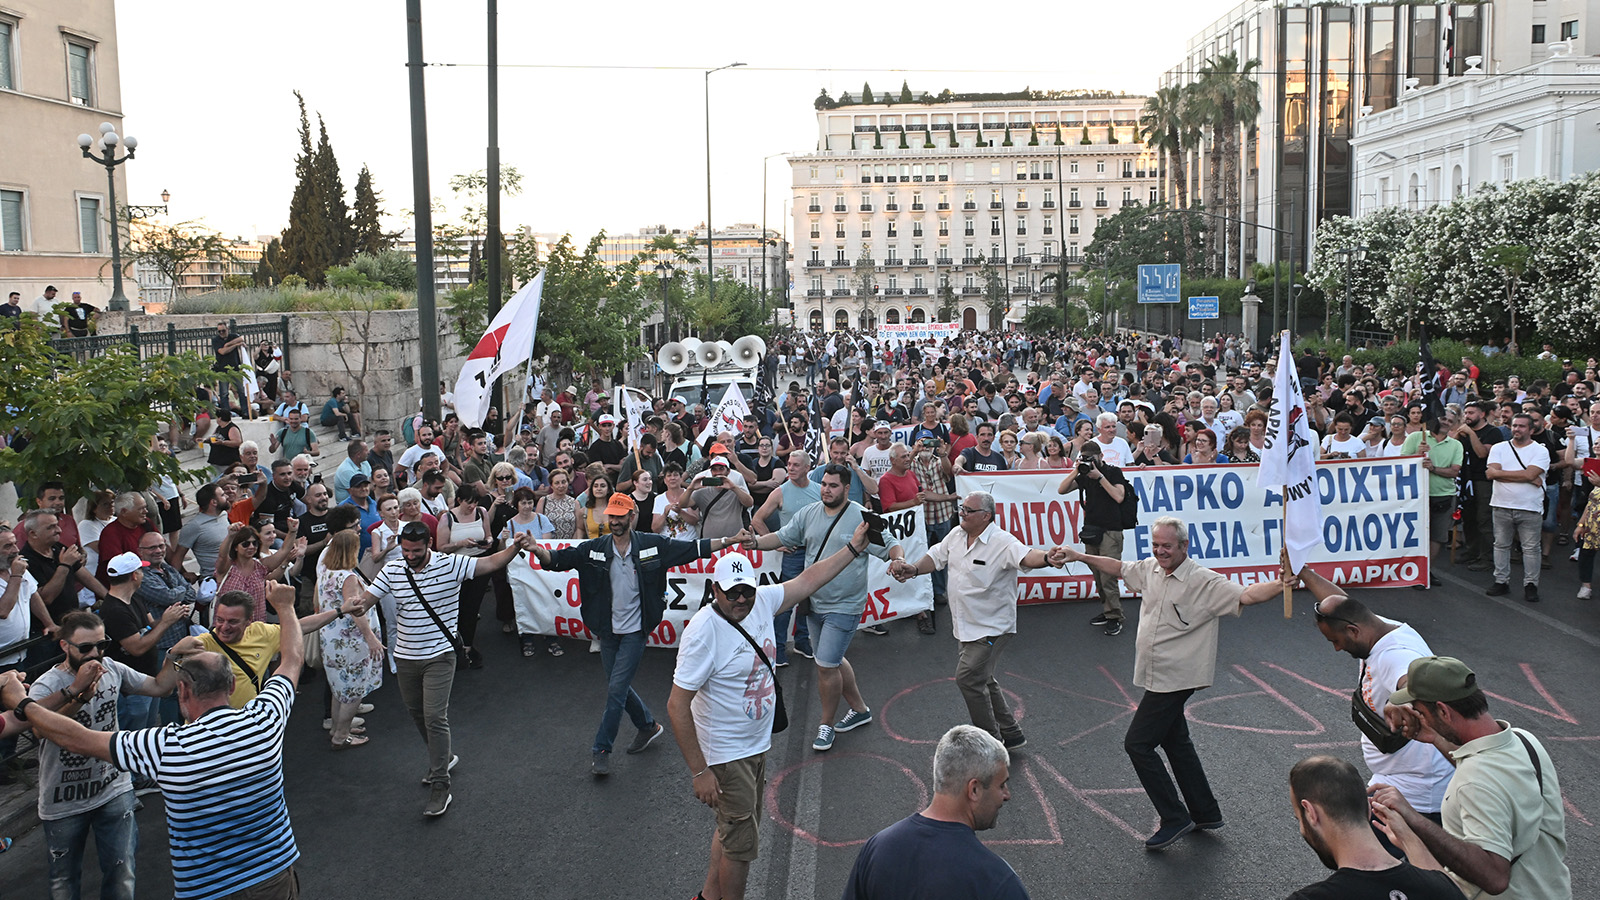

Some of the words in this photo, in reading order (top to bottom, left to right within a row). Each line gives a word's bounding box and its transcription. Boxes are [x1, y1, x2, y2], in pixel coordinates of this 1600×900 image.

[974, 463, 997, 471] HOLLISTER
[1264, 464, 1417, 507] ΑΟΙΧΤΗ
[1134, 521, 1250, 561] ΕΑΣΙΑ
[1324, 512, 1419, 553] ΟΛΟΥΣ
[1332, 562, 1419, 585] ΛΑΡΚΟ
